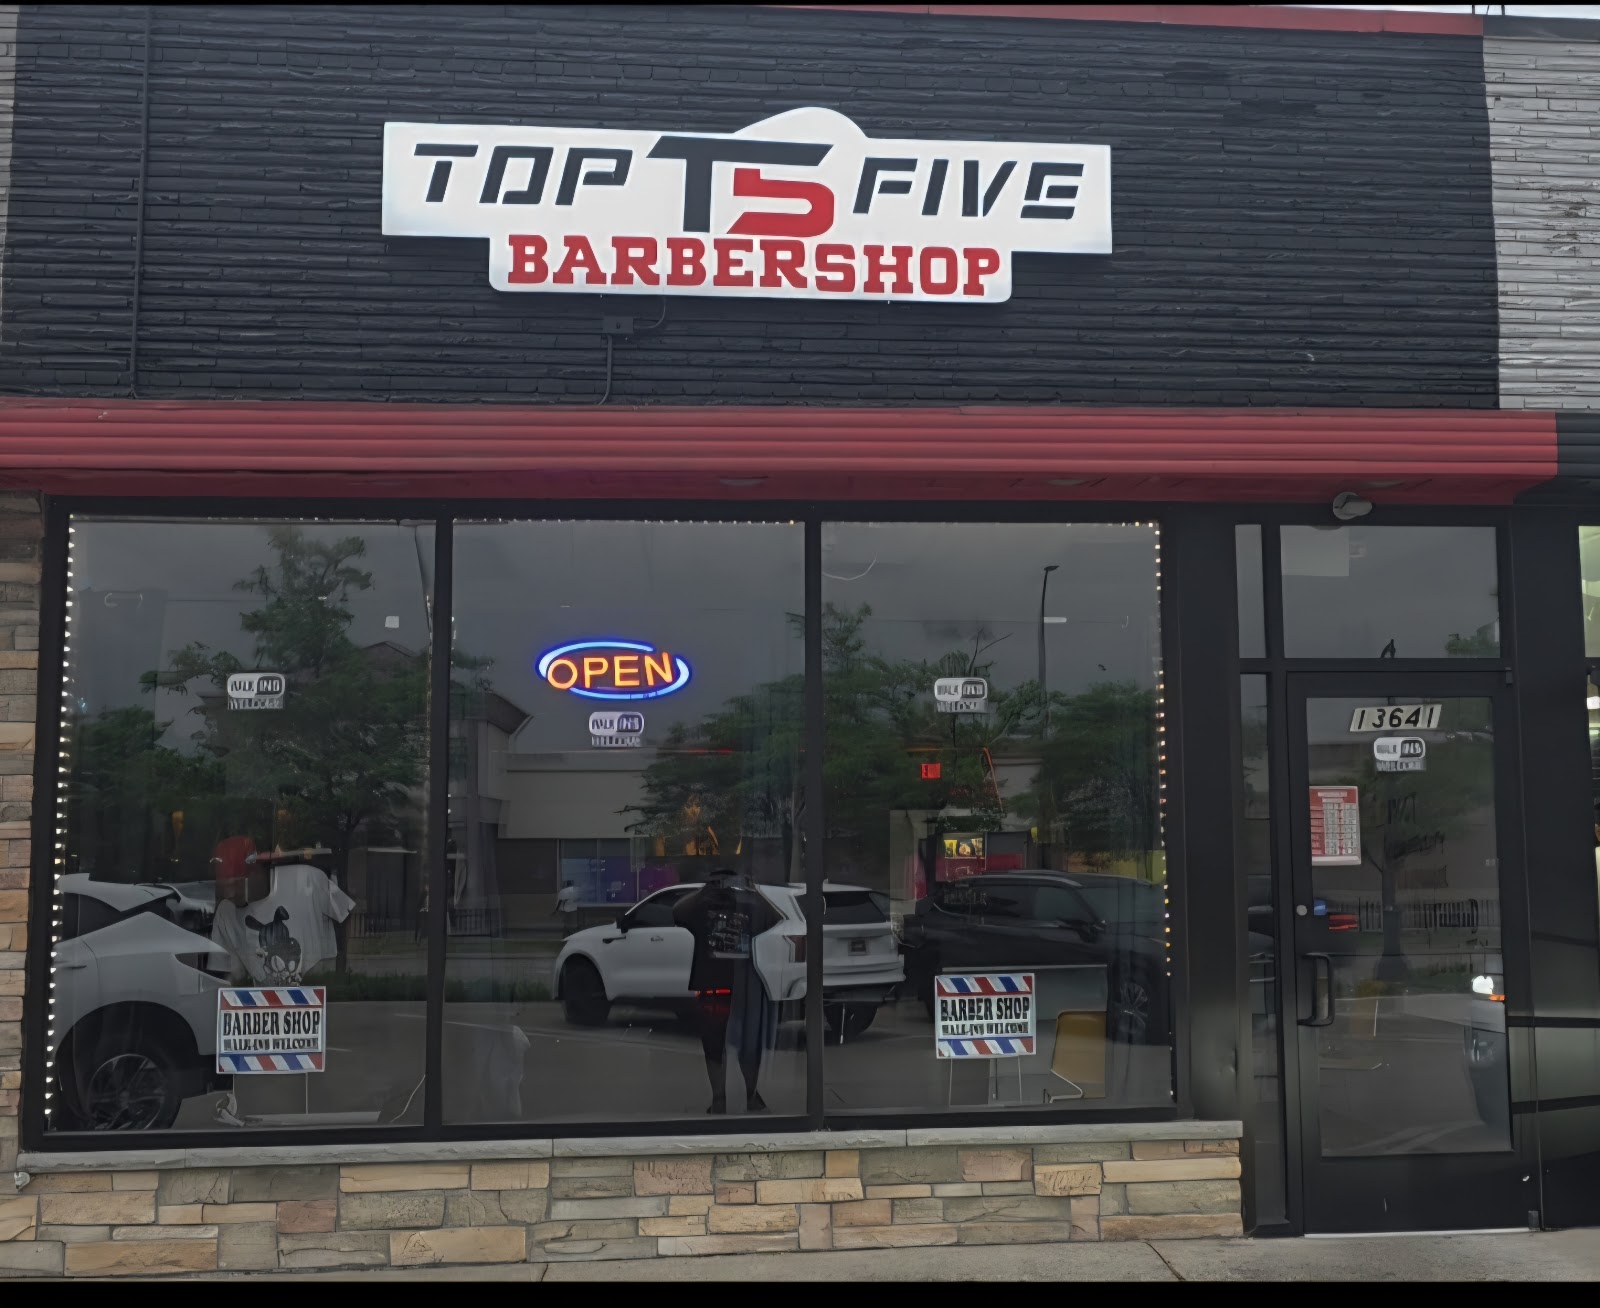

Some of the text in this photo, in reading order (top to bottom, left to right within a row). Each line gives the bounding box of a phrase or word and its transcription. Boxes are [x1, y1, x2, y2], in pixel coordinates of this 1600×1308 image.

[414, 144, 632, 205] TOP
[853, 157, 1084, 219] FIVE
[508, 235, 999, 296] BARBERSHOP
[547, 652, 673, 690] OPEN
[1357, 706, 1435, 730] 13641
[223, 1010, 320, 1036] BARBER SHOP
[940, 997, 1030, 1021] BARBER SHOP
